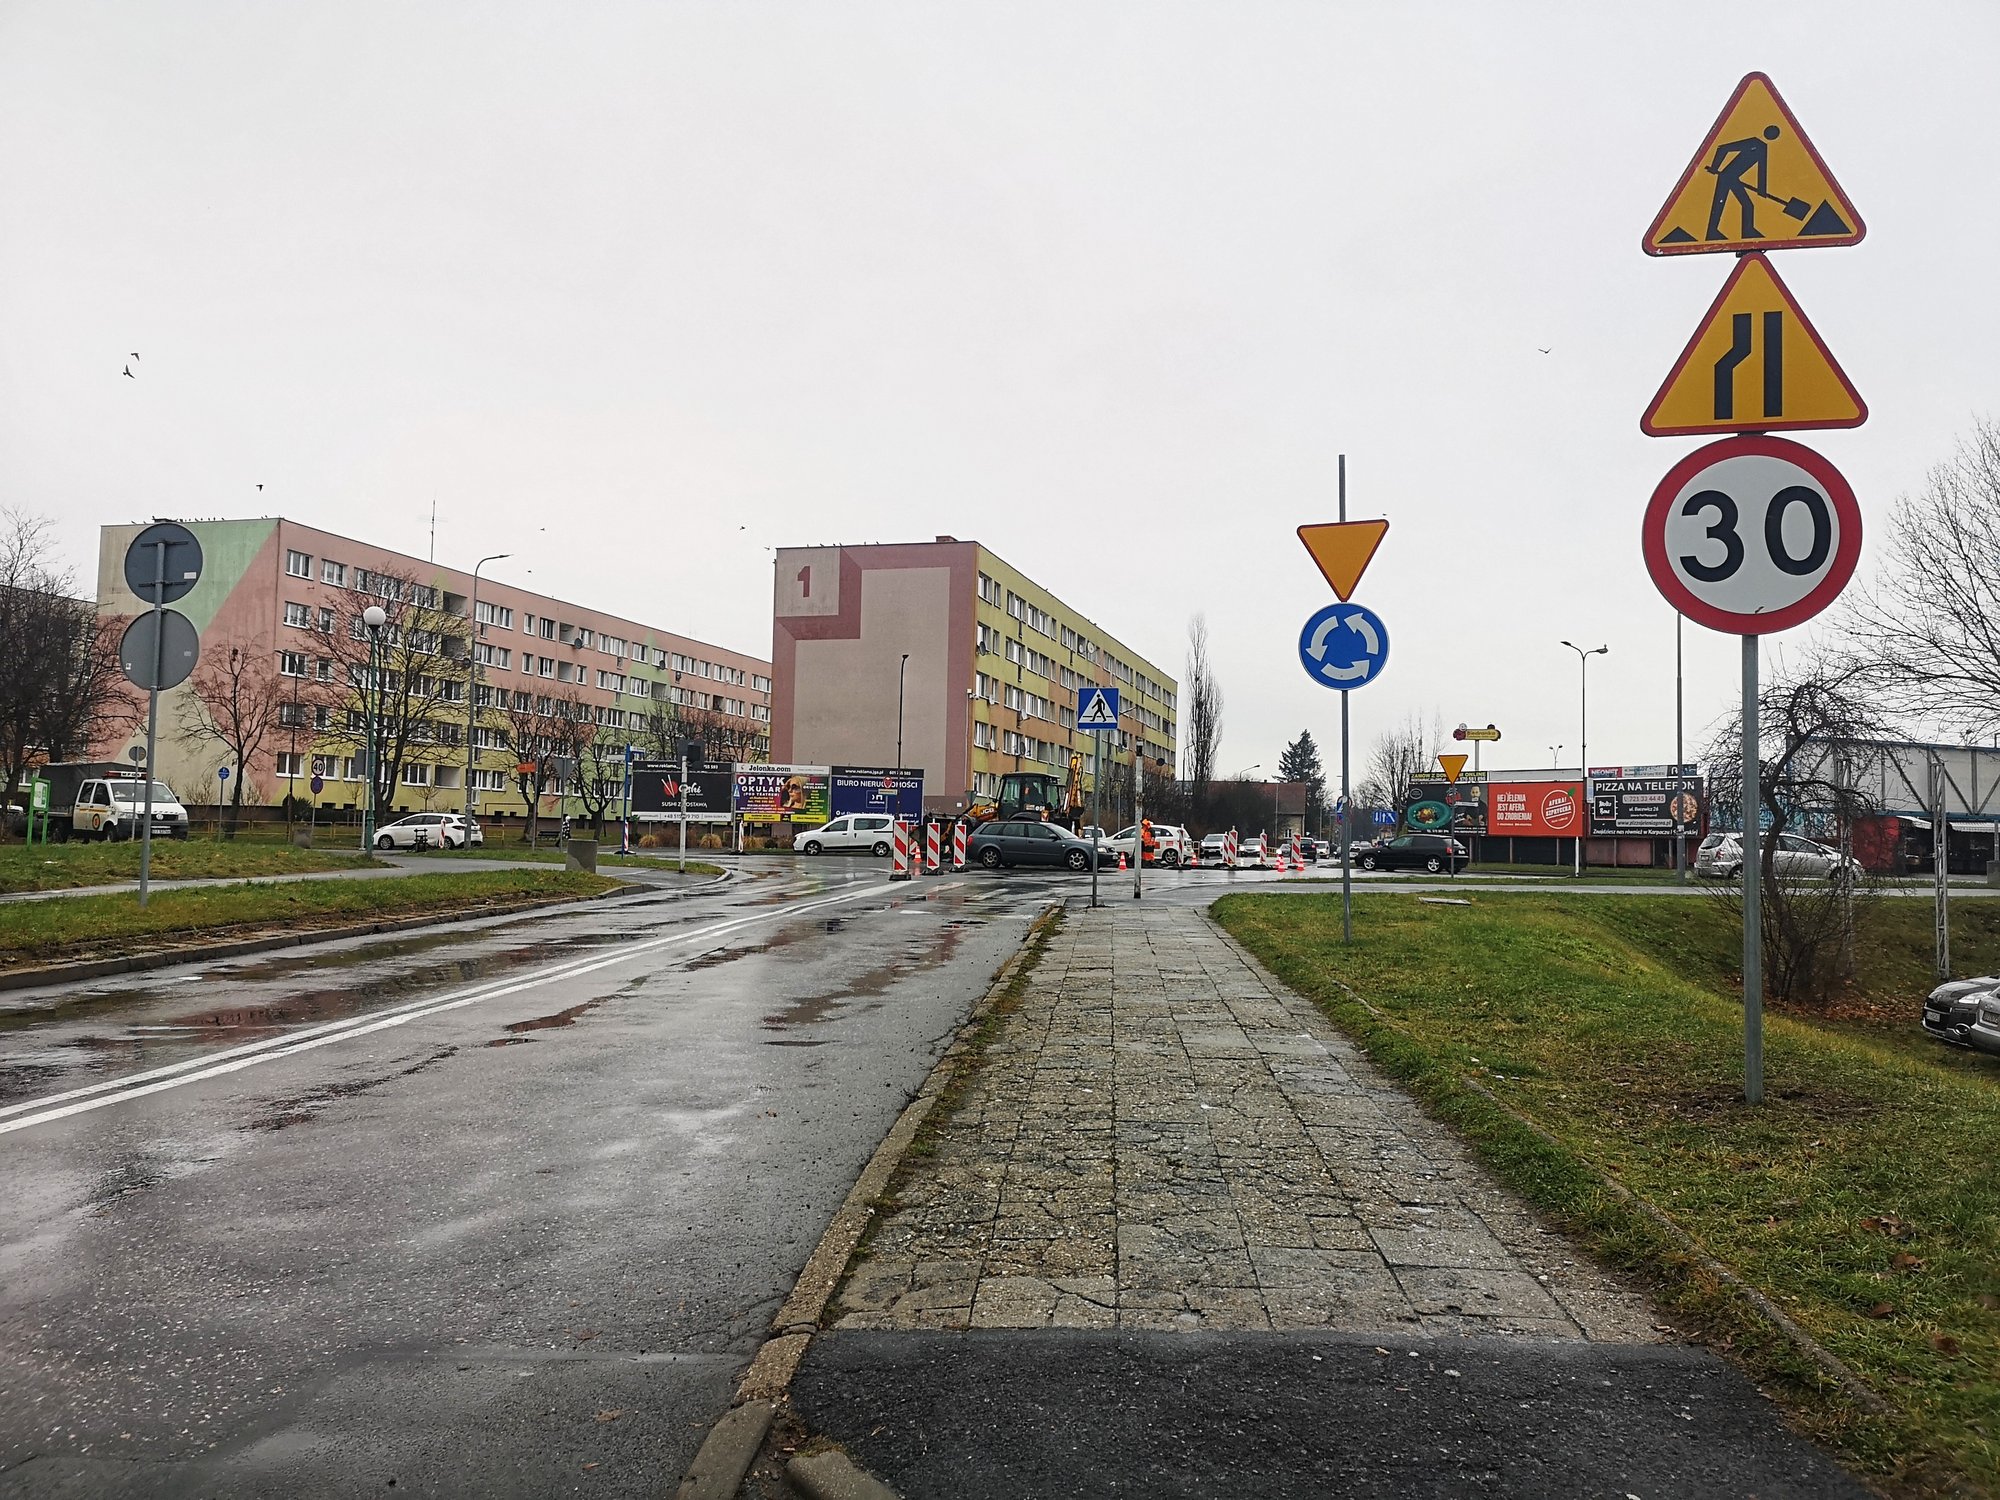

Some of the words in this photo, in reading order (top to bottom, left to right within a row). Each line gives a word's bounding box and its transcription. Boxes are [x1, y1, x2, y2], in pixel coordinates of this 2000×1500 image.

[1679, 485, 1832, 582] 30
[797, 566, 811, 597] 1
[313, 762, 324, 771] 40
[738, 776, 785, 785] OPTYK
[1595, 782, 1625, 791] PIZZA
[1627, 782, 1643, 791] NA
[1497, 794, 1506, 802] HEJ
[981, 807, 995, 815] JCB
[1497, 803, 1508, 811] JEST
[1509, 803, 1525, 811] AFERA
[1497, 812, 1504, 820] DO
